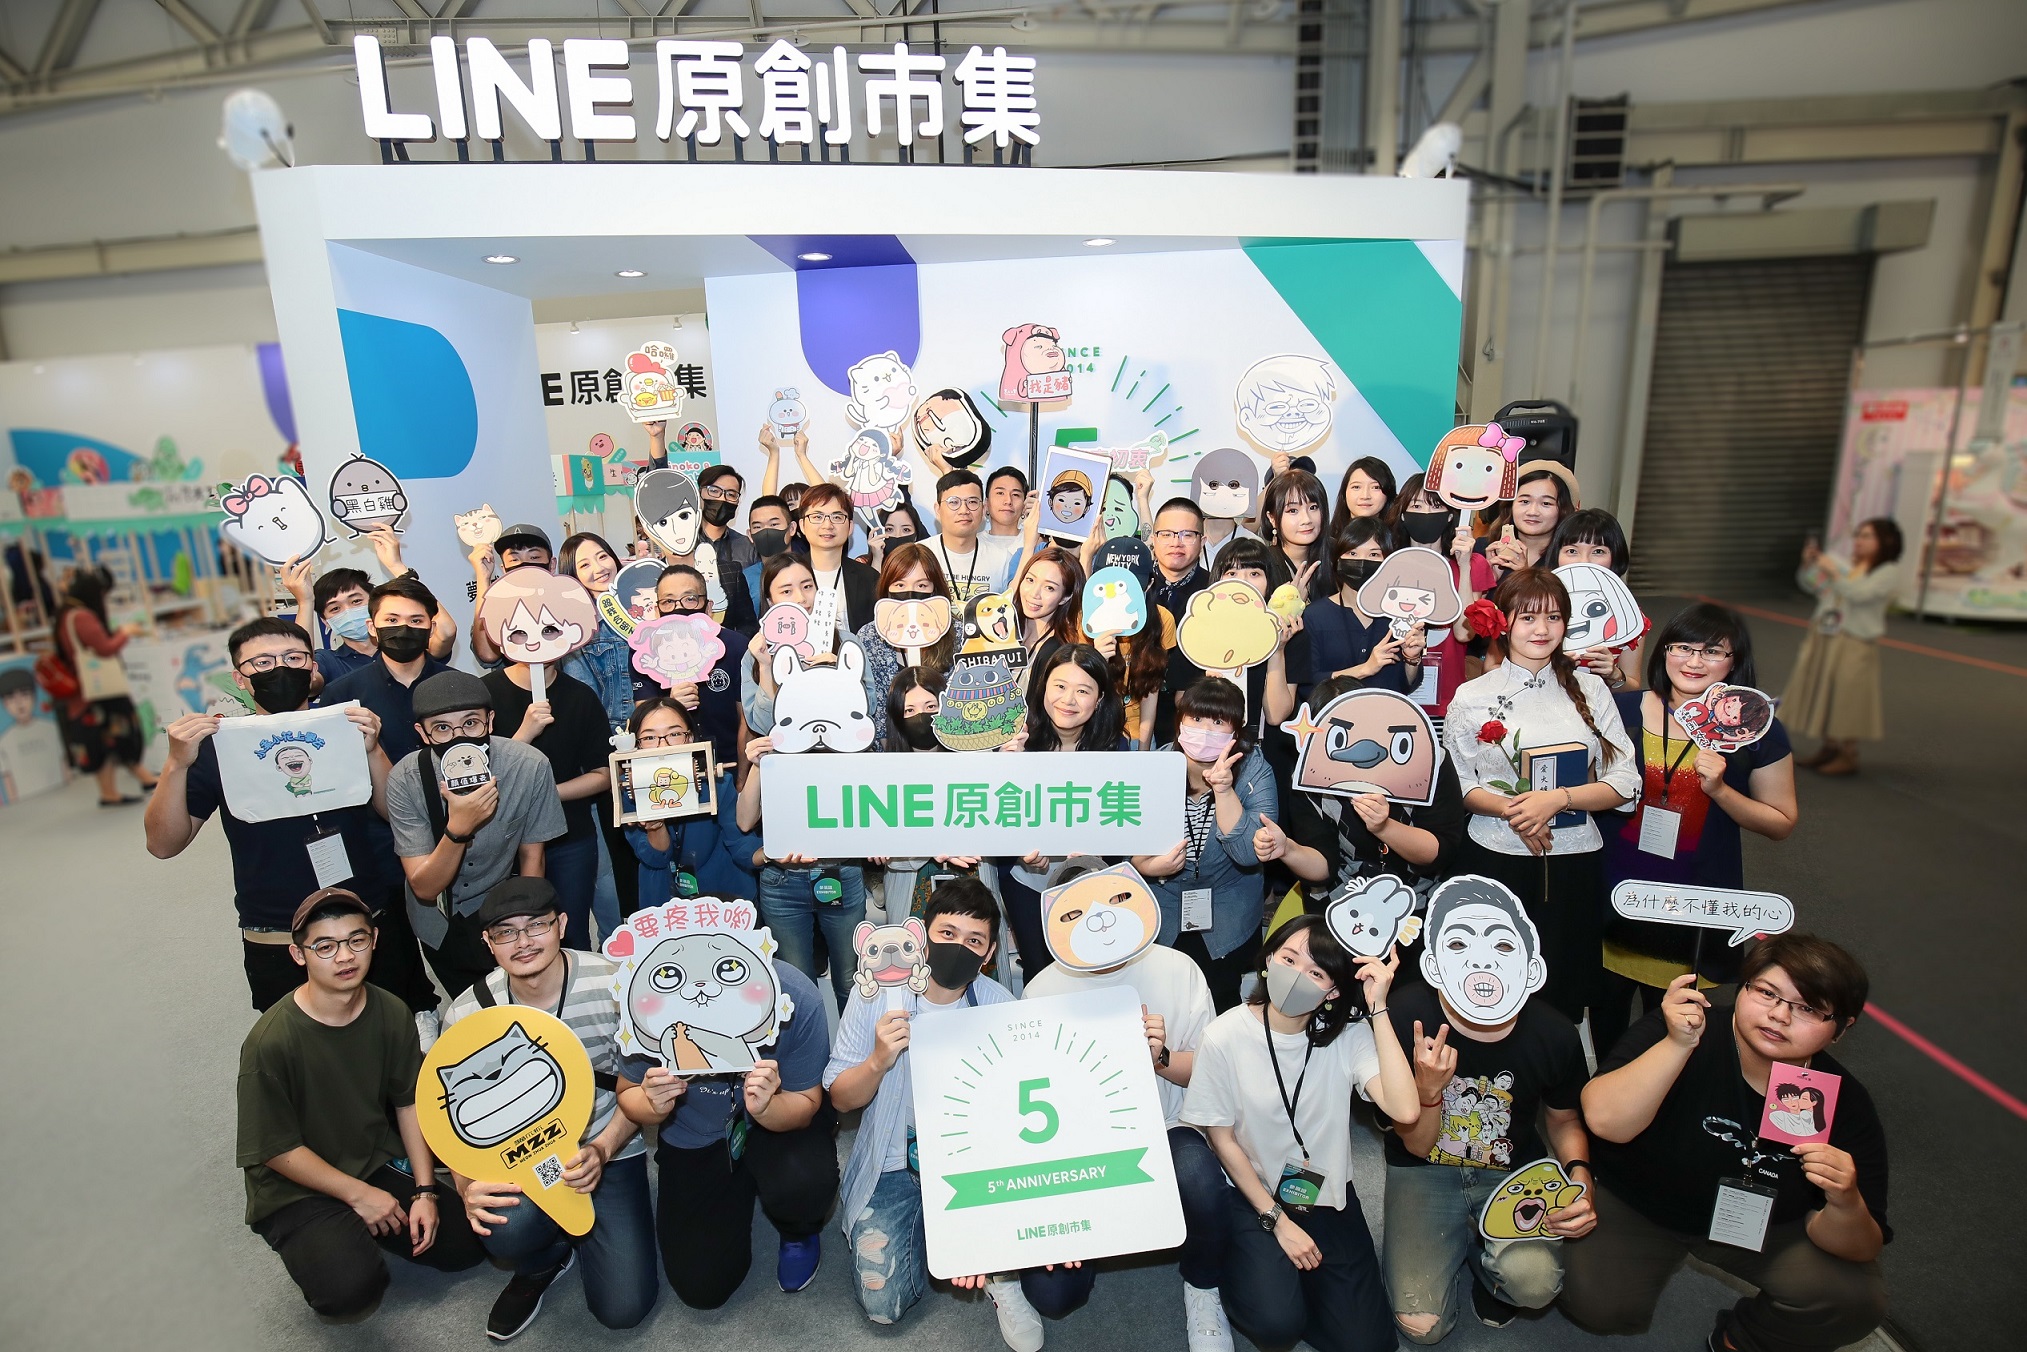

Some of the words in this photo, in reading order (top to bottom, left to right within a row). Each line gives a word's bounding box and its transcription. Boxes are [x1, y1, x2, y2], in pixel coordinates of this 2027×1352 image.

[354, 35, 637, 141] LINE
[655, 38, 1041, 146] 原創市集
[1067, 346, 1100, 358] NCE
[1066, 362, 1094, 373] 014
[570, 363, 707, 405] 原創集
[1106, 553, 1120, 565] NEW
[1120, 554, 1140, 566] YORK
[961, 652, 1022, 669] SHIBAUI
[806, 784, 934, 829] LINE
[943, 781, 1142, 828] 原創市集
[1623, 891, 1783, 921] 為什麼不懂我的心
[633, 902, 752, 938] 要疼我喲
[1007, 1020, 1043, 1031] SINCE
[1012, 1031, 1041, 1042] 2014
[1019, 1077, 1060, 1144] 5
[505, 1122, 562, 1164] MZZ
[987, 1179, 1005, 1194] 5th
[1006, 1165, 1107, 1191] ANNIVERSARY
[1758, 1167, 1779, 1179] CANADA
[1016, 1226, 1046, 1240] LINE
[1047, 1219, 1092, 1237] 原創市集
